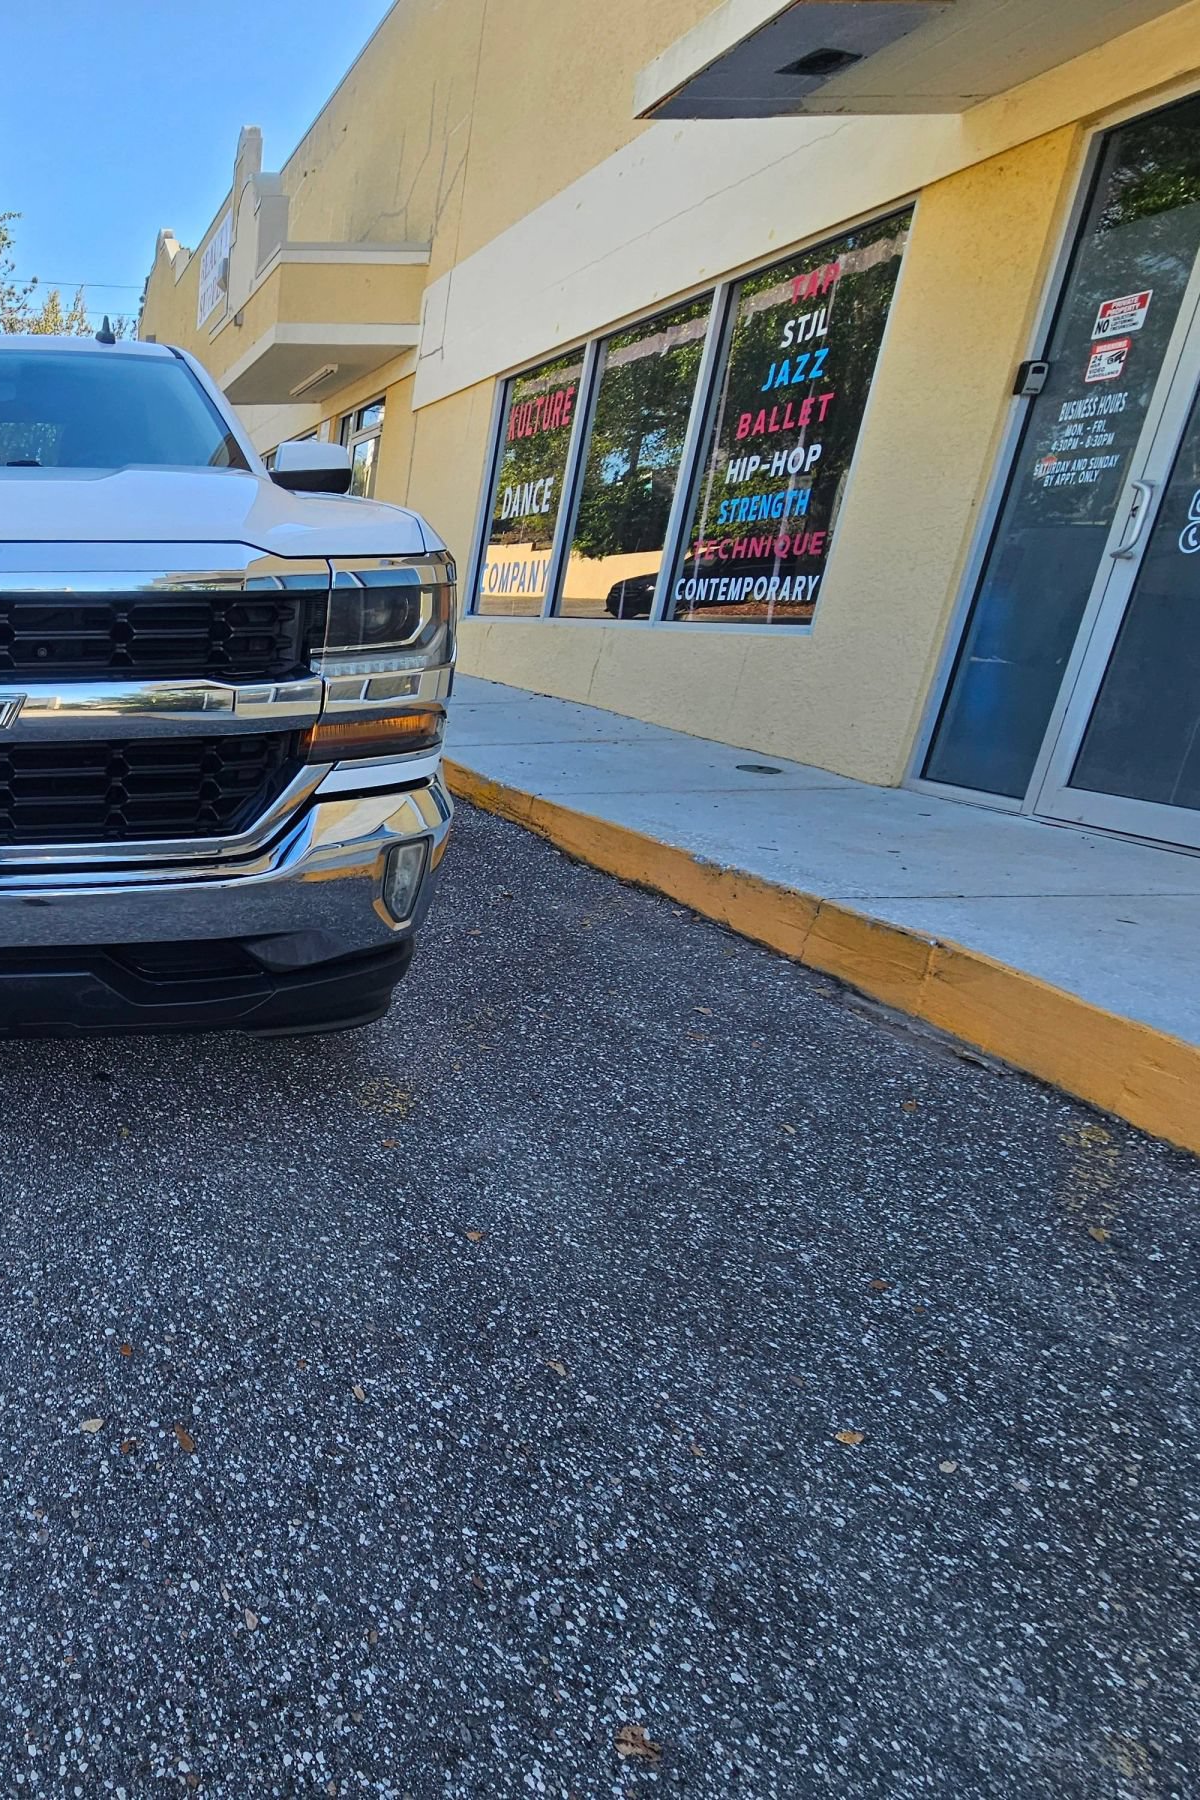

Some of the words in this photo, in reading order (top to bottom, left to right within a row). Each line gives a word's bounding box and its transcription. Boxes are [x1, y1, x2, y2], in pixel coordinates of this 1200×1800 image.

[791, 262, 841, 304] TAP
[1094, 319, 1110, 335] NO
[761, 348, 829, 391] JAZZ
[1091, 354, 1103, 364] 24
[507, 386, 576, 441] KULTURE
[736, 392, 834, 440] BALLET
[1058, 397, 1098, 422] BUSINESS
[1096, 392, 1128, 416] HOURS
[1064, 423, 1084, 437] MON.
[1091, 420, 1106, 433] FRI.
[1051, 437, 1080, 452] 4:30PM
[725, 444, 822, 484] HIP-HOP
[1033, 460, 1071, 477] SATURDAY
[1070, 458, 1088, 471] AND
[1088, 454, 1120, 470] SUNDAY
[1043, 474, 1056, 487] BY
[1054, 472, 1076, 486] APPT.
[1078, 470, 1100, 483] ONLY
[501, 476, 554, 520] DANCE
[717, 488, 811, 524] STRENGTH
[693, 531, 826, 560] TECHNIQUE
[480, 559, 551, 593] COMPANY
[675, 575, 820, 601] CONTEMPORARY
